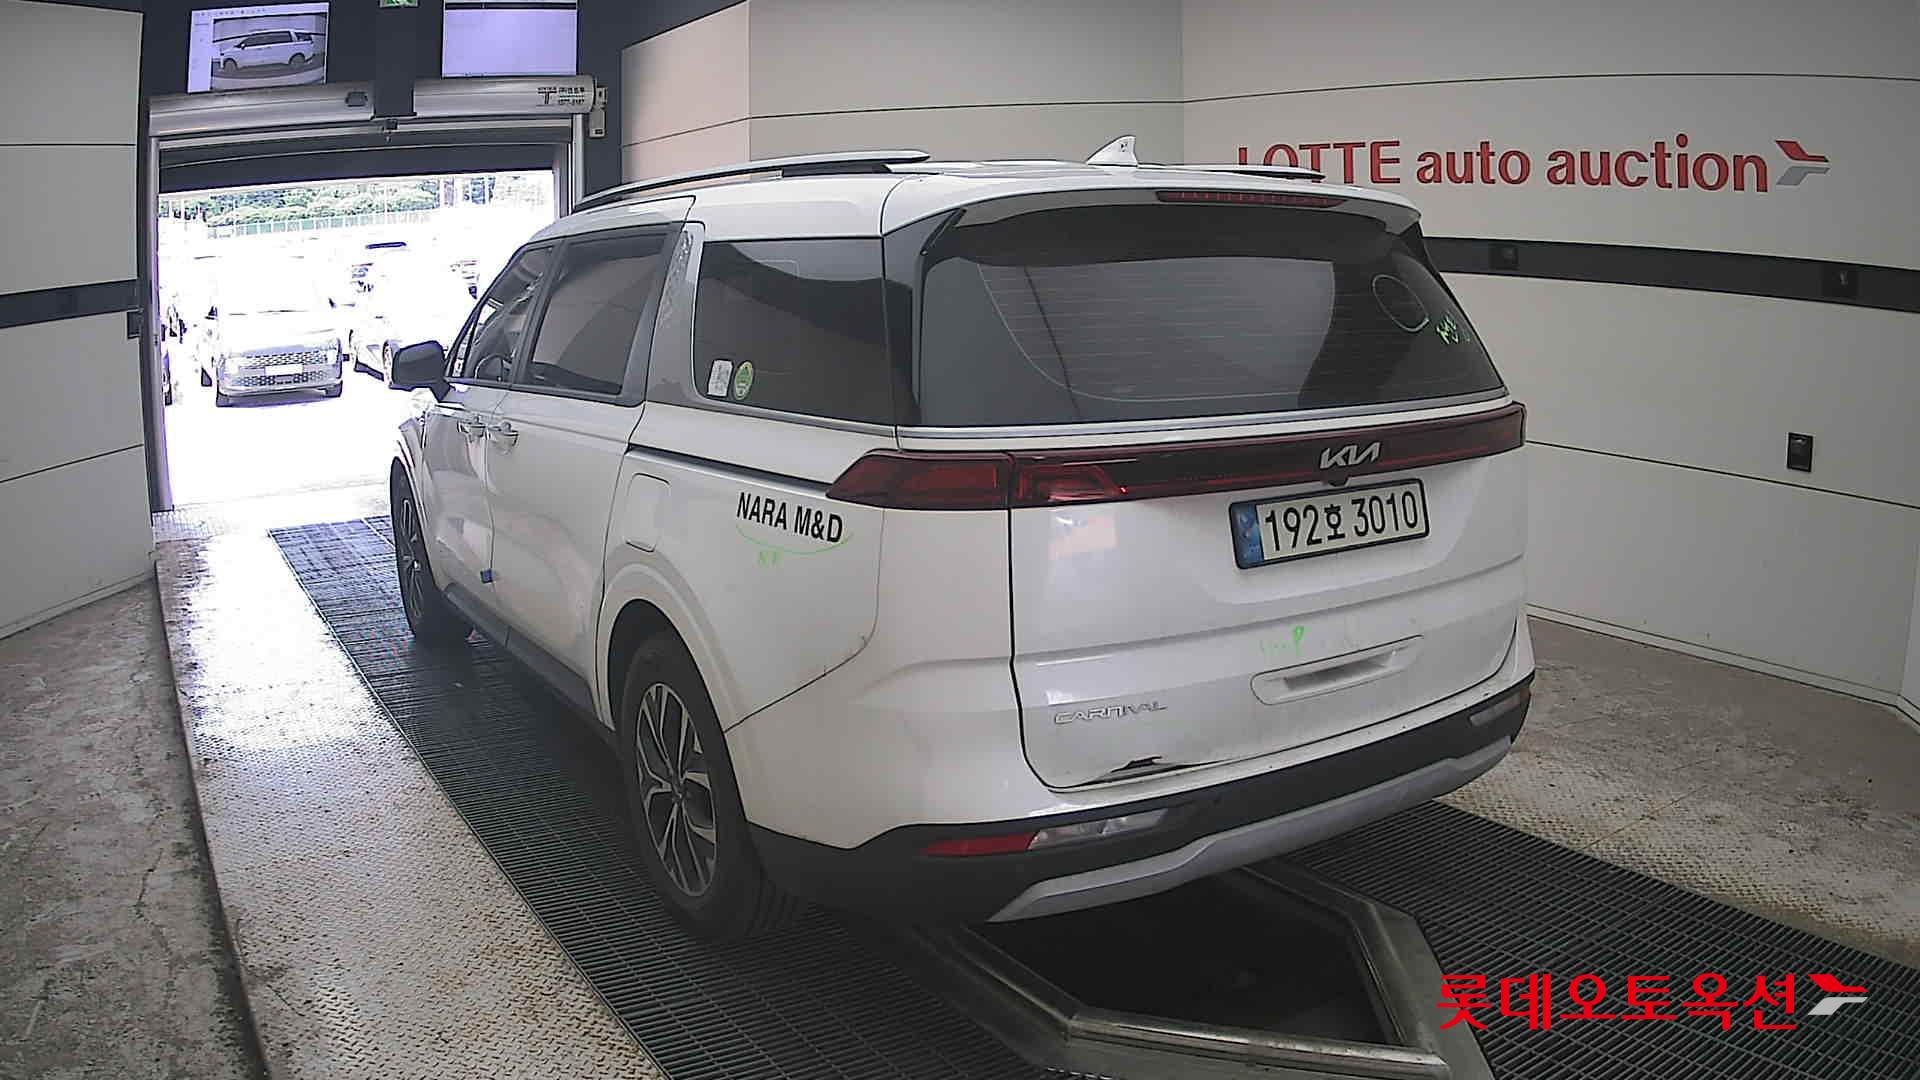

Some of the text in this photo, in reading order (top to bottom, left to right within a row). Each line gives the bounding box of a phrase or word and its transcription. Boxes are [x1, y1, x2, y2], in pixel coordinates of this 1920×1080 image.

[1416, 140, 1530, 186] auto
[1546, 133, 1769, 193] auction
[736, 491, 843, 543] NARA M&D
[1265, 490, 1419, 552] 192호 3010
[1054, 701, 1169, 725] CARNIVAL
